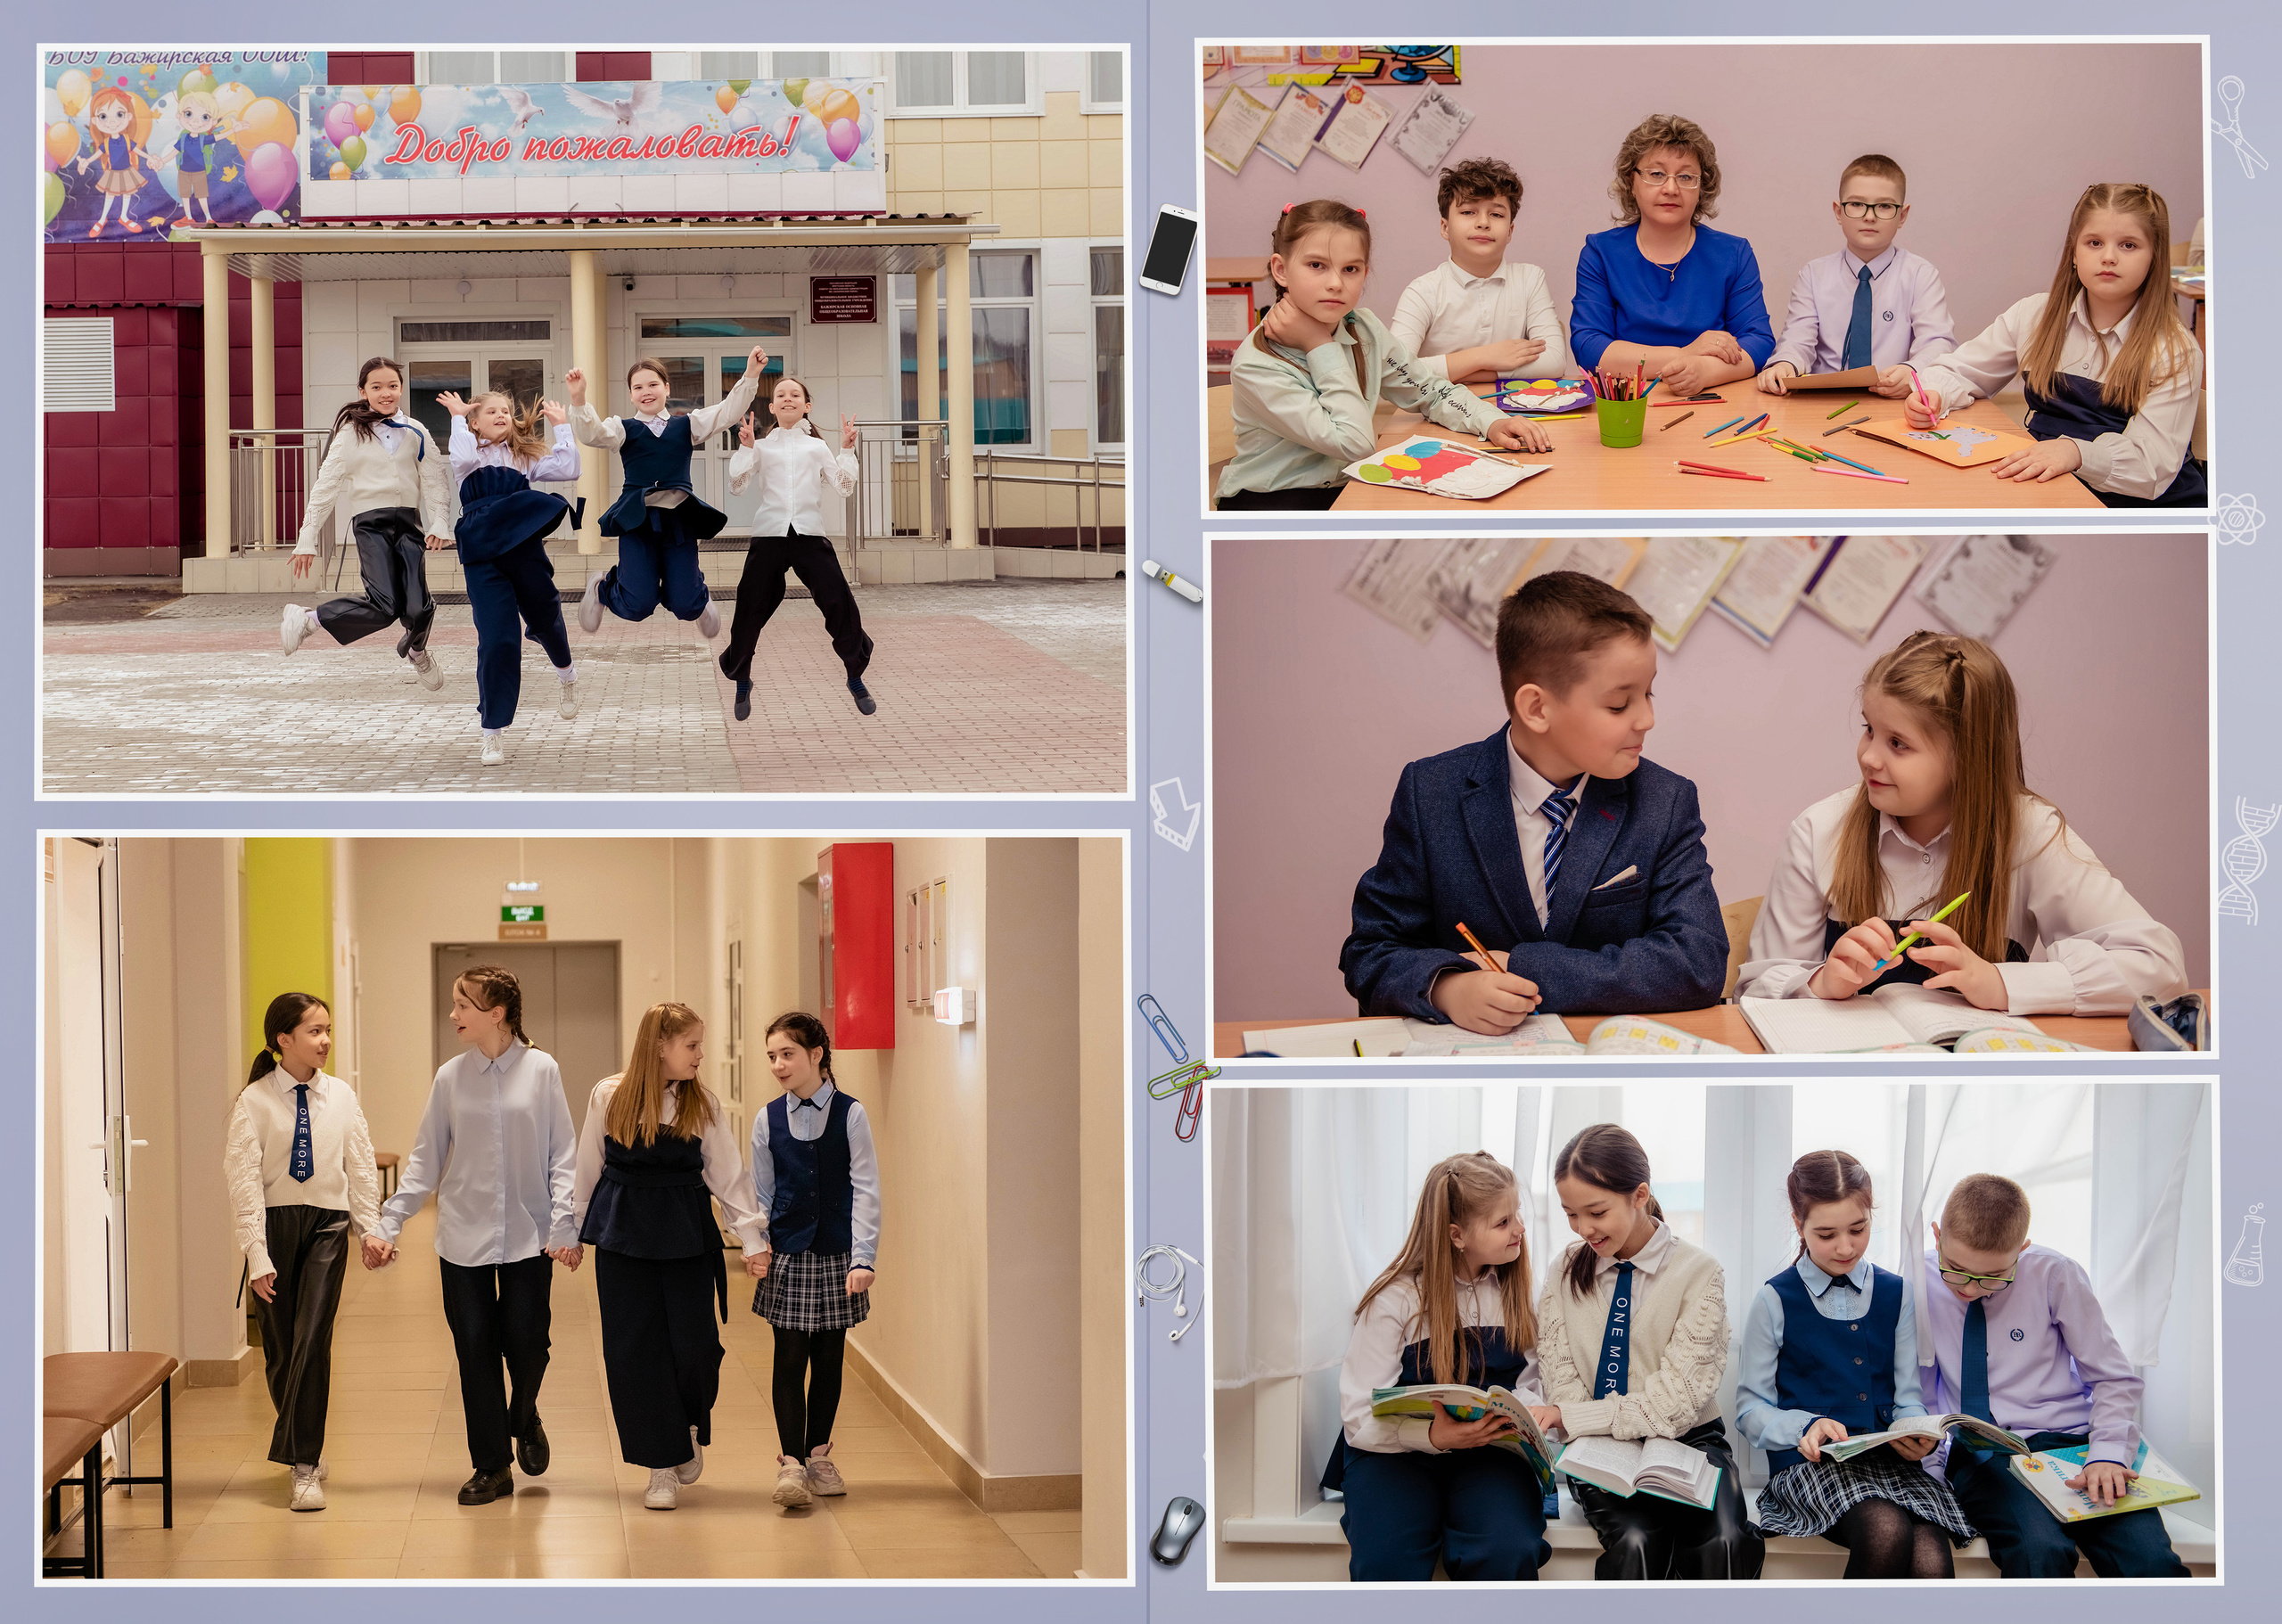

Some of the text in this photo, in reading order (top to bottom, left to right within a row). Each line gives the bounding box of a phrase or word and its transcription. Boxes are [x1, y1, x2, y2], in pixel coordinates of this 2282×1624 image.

[45, 52, 98, 65] БОУ
[384, 115, 800, 176] Добро пожаловать!
[297, 1107, 308, 1177] ONE MORE
[1605, 1297, 1628, 1397] ONE MOR
[2047, 1460, 2100, 1510] Матетика
